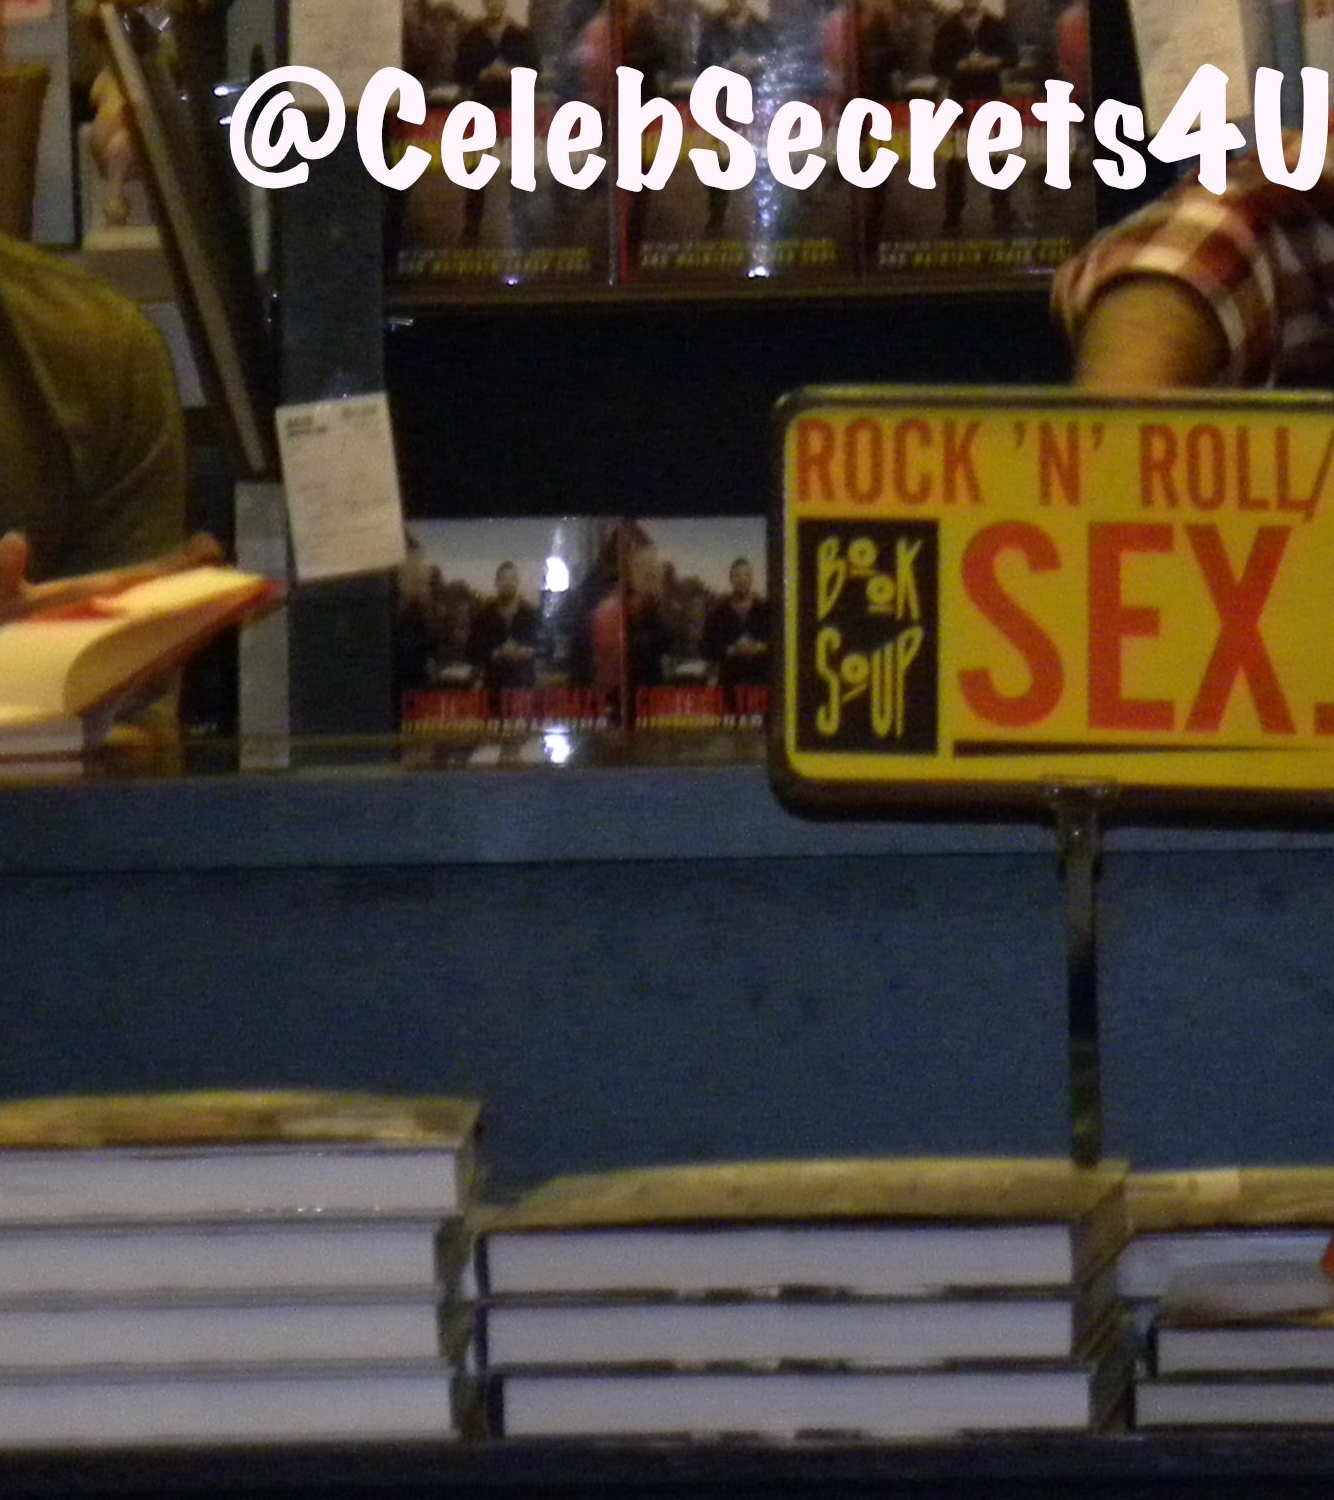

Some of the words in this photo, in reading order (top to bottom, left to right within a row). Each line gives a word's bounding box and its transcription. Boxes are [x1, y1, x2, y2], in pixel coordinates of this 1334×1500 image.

[794, 417, 983, 506] ROCK
[1015, 420, 1105, 508] 'N'
[816, 536, 925, 623] BOOK
[815, 626, 925, 740] SOUP
